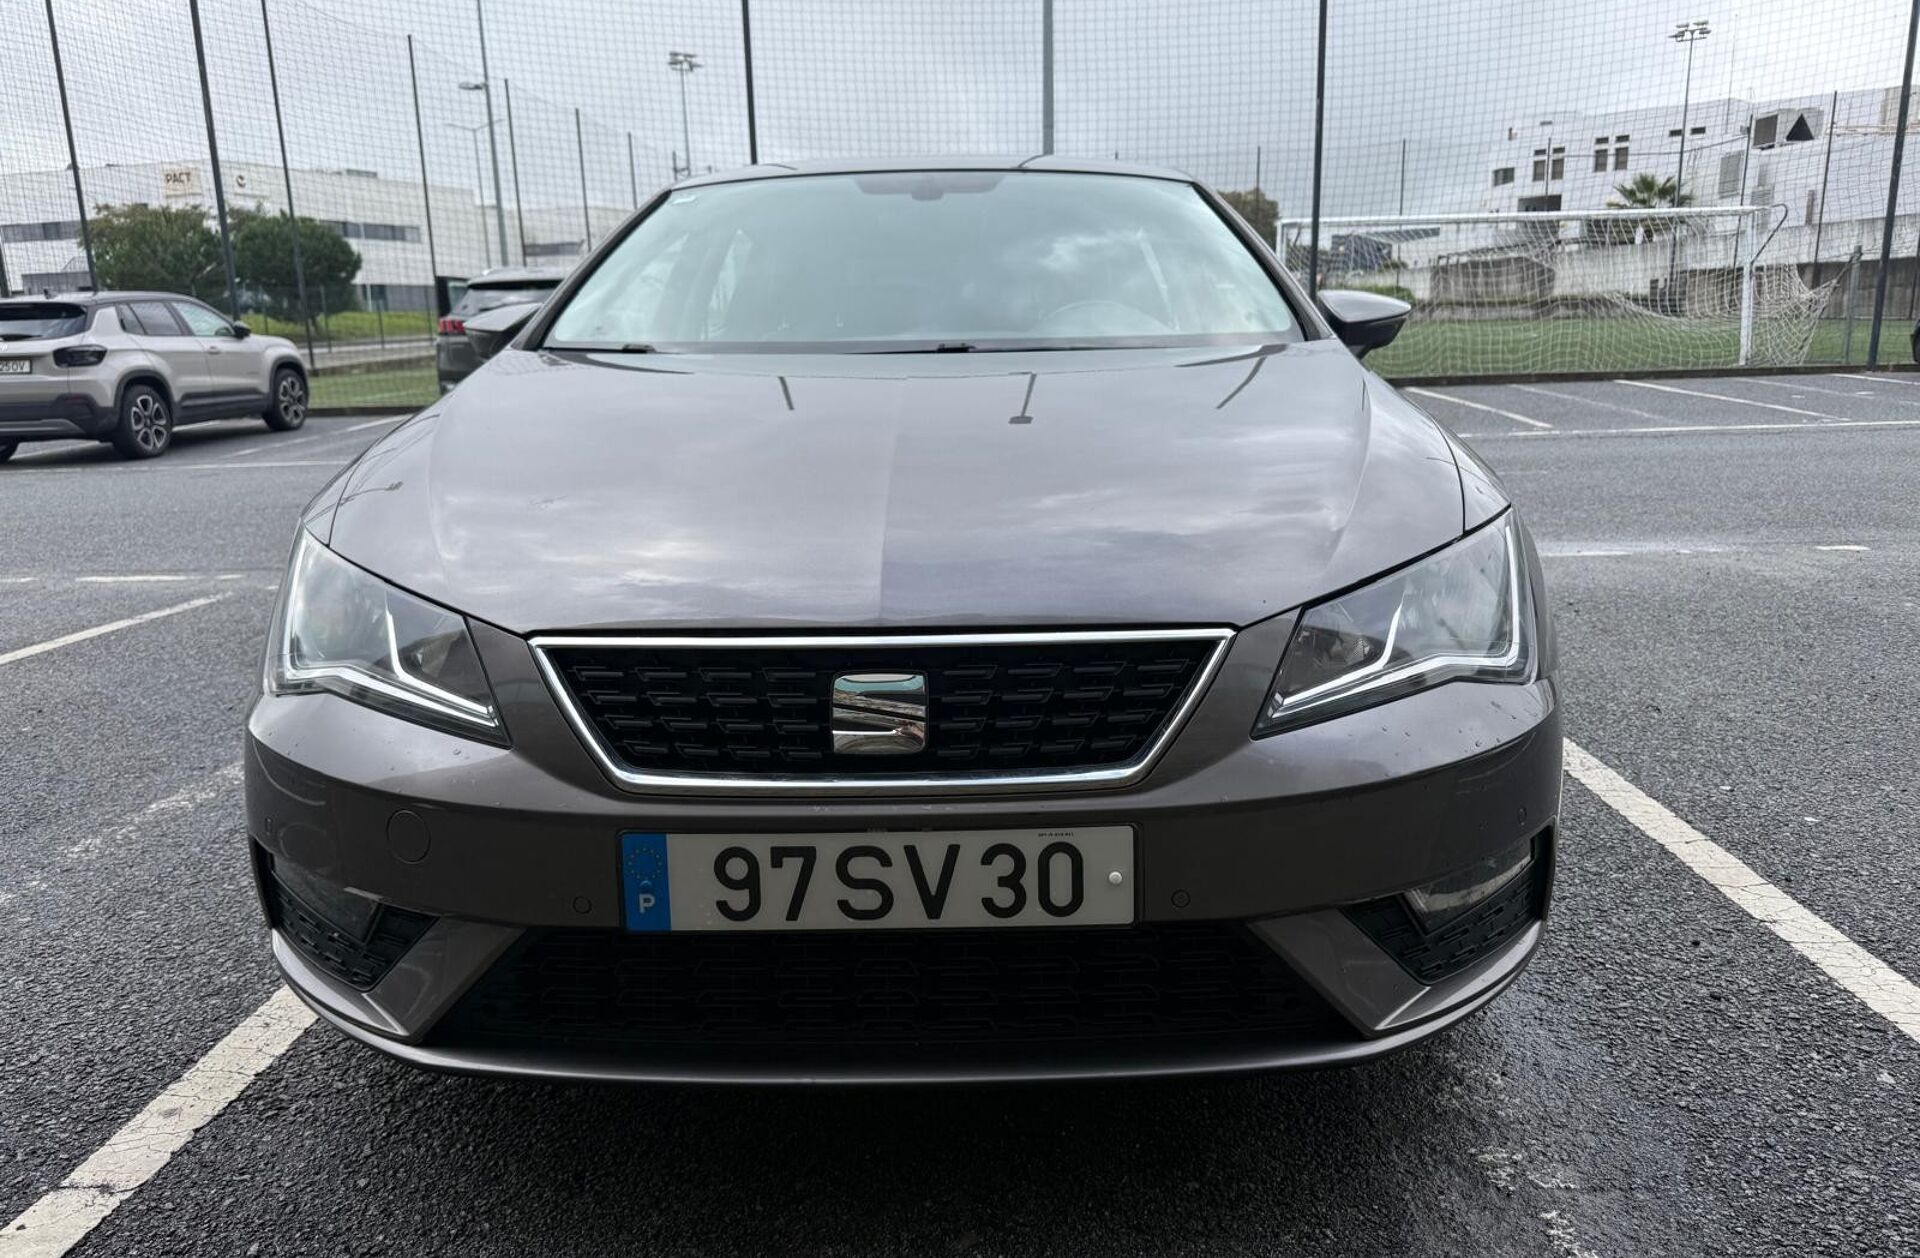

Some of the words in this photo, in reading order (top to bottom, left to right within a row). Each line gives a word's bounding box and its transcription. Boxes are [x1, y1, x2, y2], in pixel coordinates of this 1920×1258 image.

[165, 171, 191, 184] PACT
[712, 841, 1085, 922] 97SV30
[639, 893, 656, 914] P
